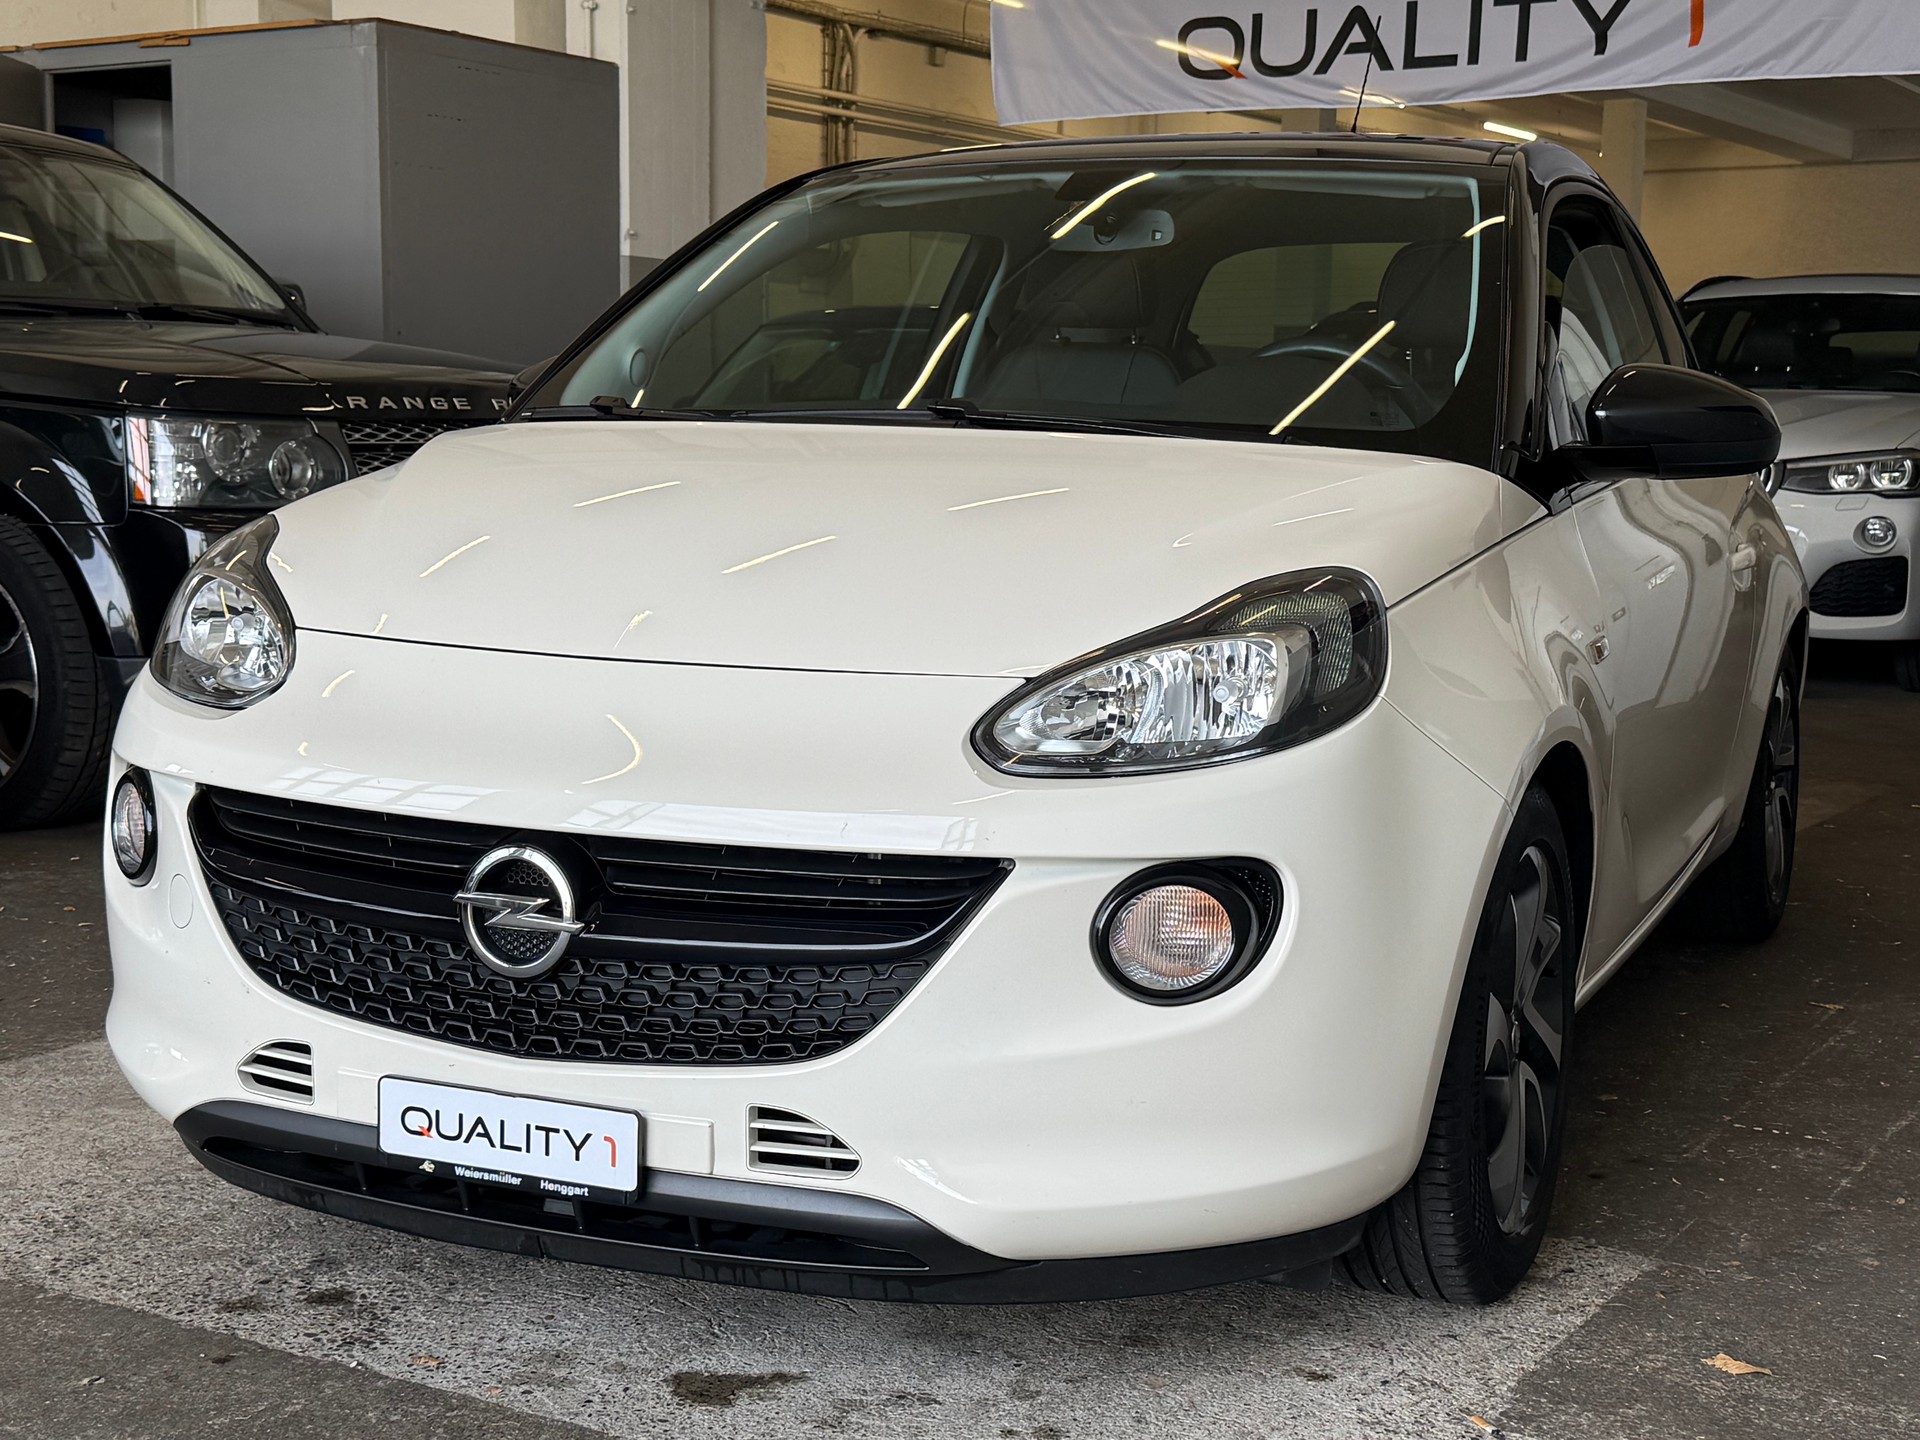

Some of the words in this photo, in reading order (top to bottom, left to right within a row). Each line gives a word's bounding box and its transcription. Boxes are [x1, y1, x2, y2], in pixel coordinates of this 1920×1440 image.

[1177, 0, 1631, 80] QUALITY
[346, 395, 472, 410] RANGE
[400, 1105, 593, 1162] QUALITY
[454, 1165, 522, 1185] Weiersmüller
[540, 1179, 589, 1196] Henggart
